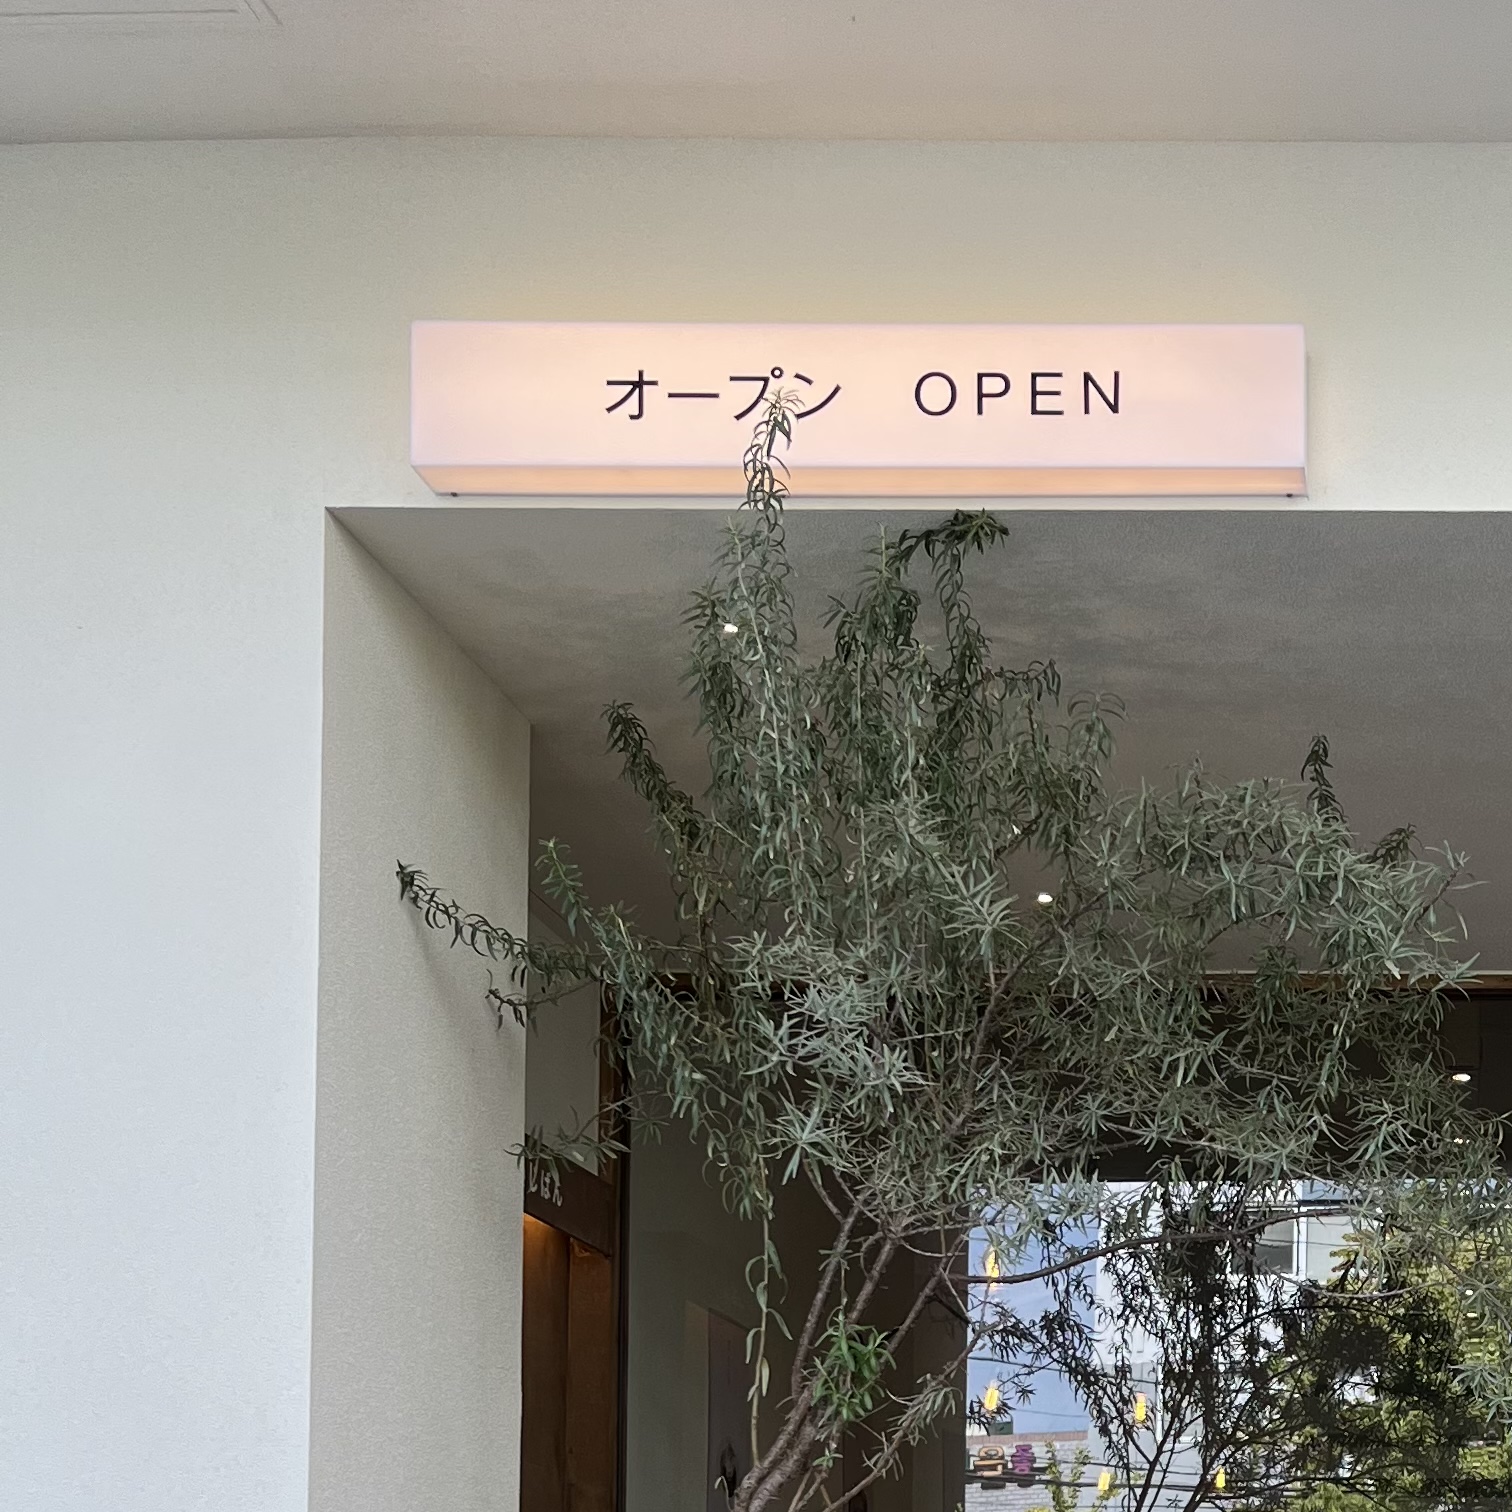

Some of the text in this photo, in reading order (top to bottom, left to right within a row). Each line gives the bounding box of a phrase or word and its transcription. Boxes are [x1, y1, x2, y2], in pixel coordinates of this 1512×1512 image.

[604, 367, 1121, 421] オープン OPEN
